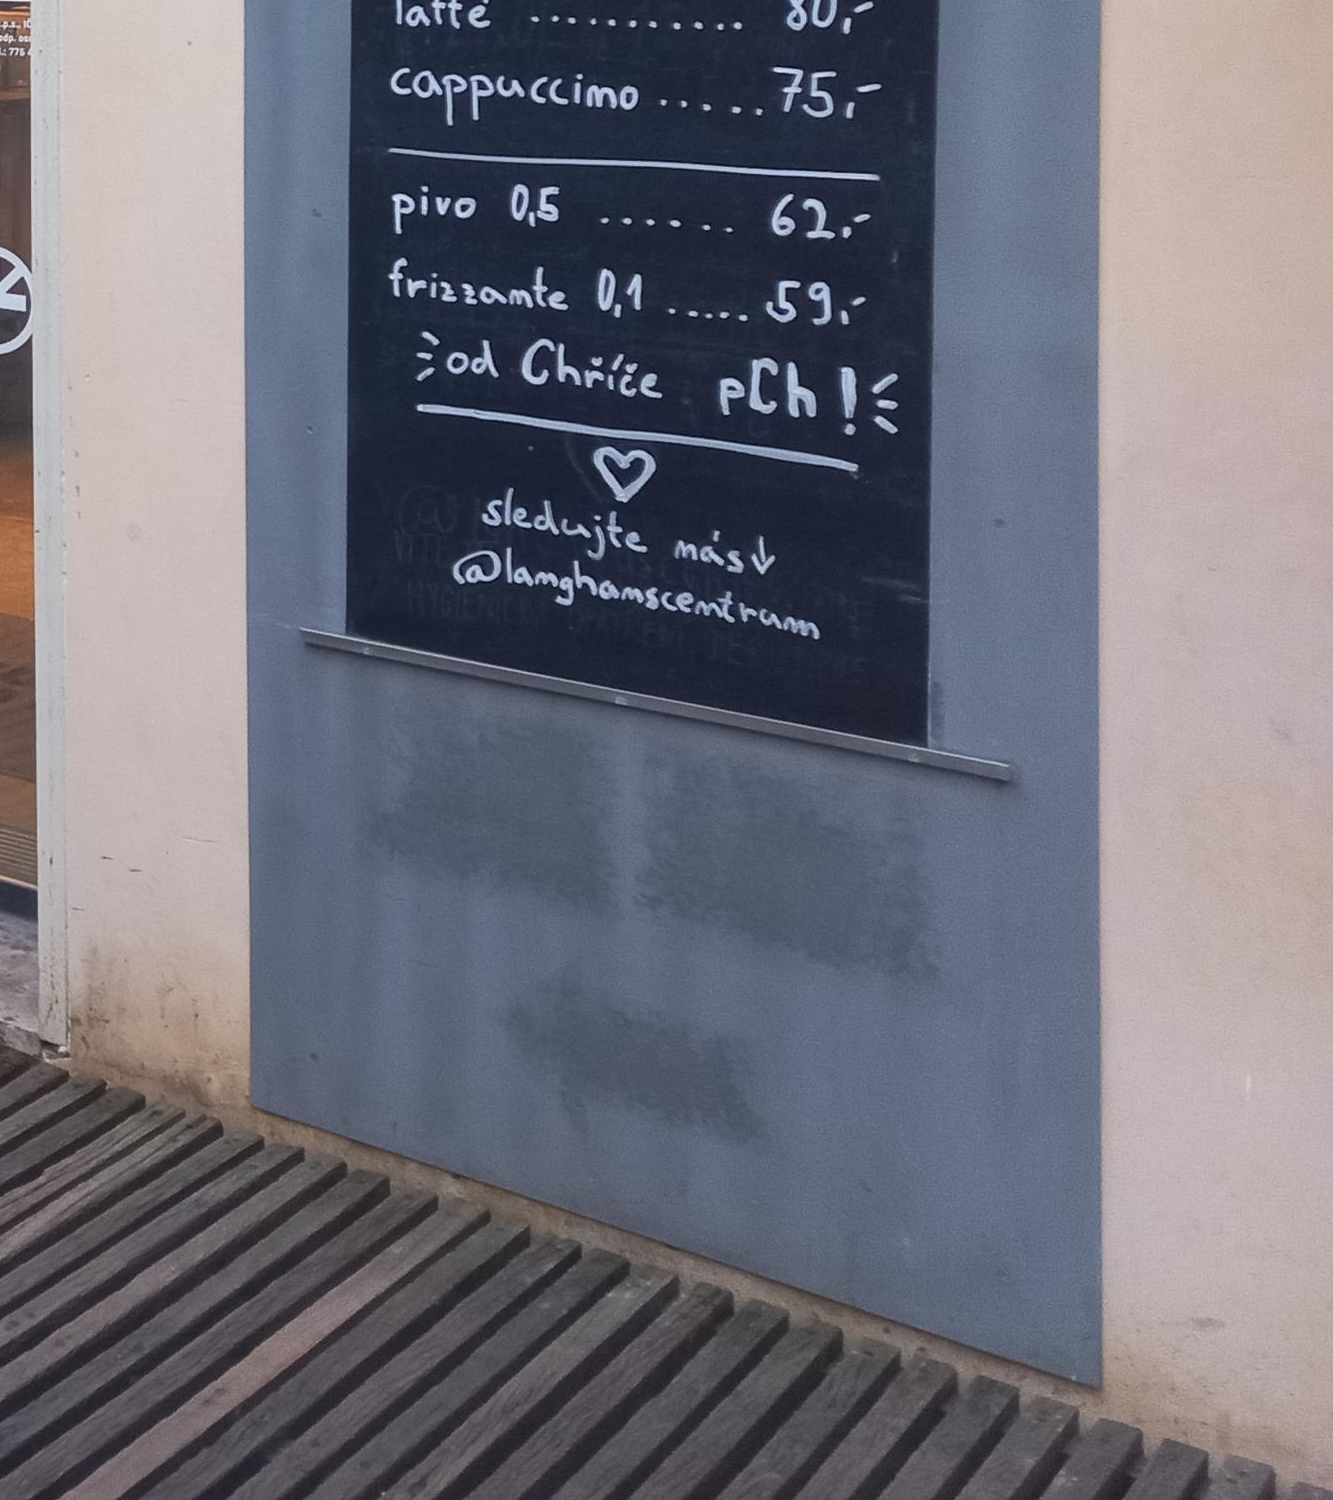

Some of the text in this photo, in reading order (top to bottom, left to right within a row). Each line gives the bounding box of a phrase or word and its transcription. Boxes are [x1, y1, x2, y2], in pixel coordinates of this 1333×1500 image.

[391, 185, 477, 235] pivo
[510, 183, 560, 228] 0,5
[388, 257, 569, 311] frizzante
[597, 268, 642, 318] 0,1
[446, 339, 499, 378] od
[482, 487, 648, 560] sledujte
